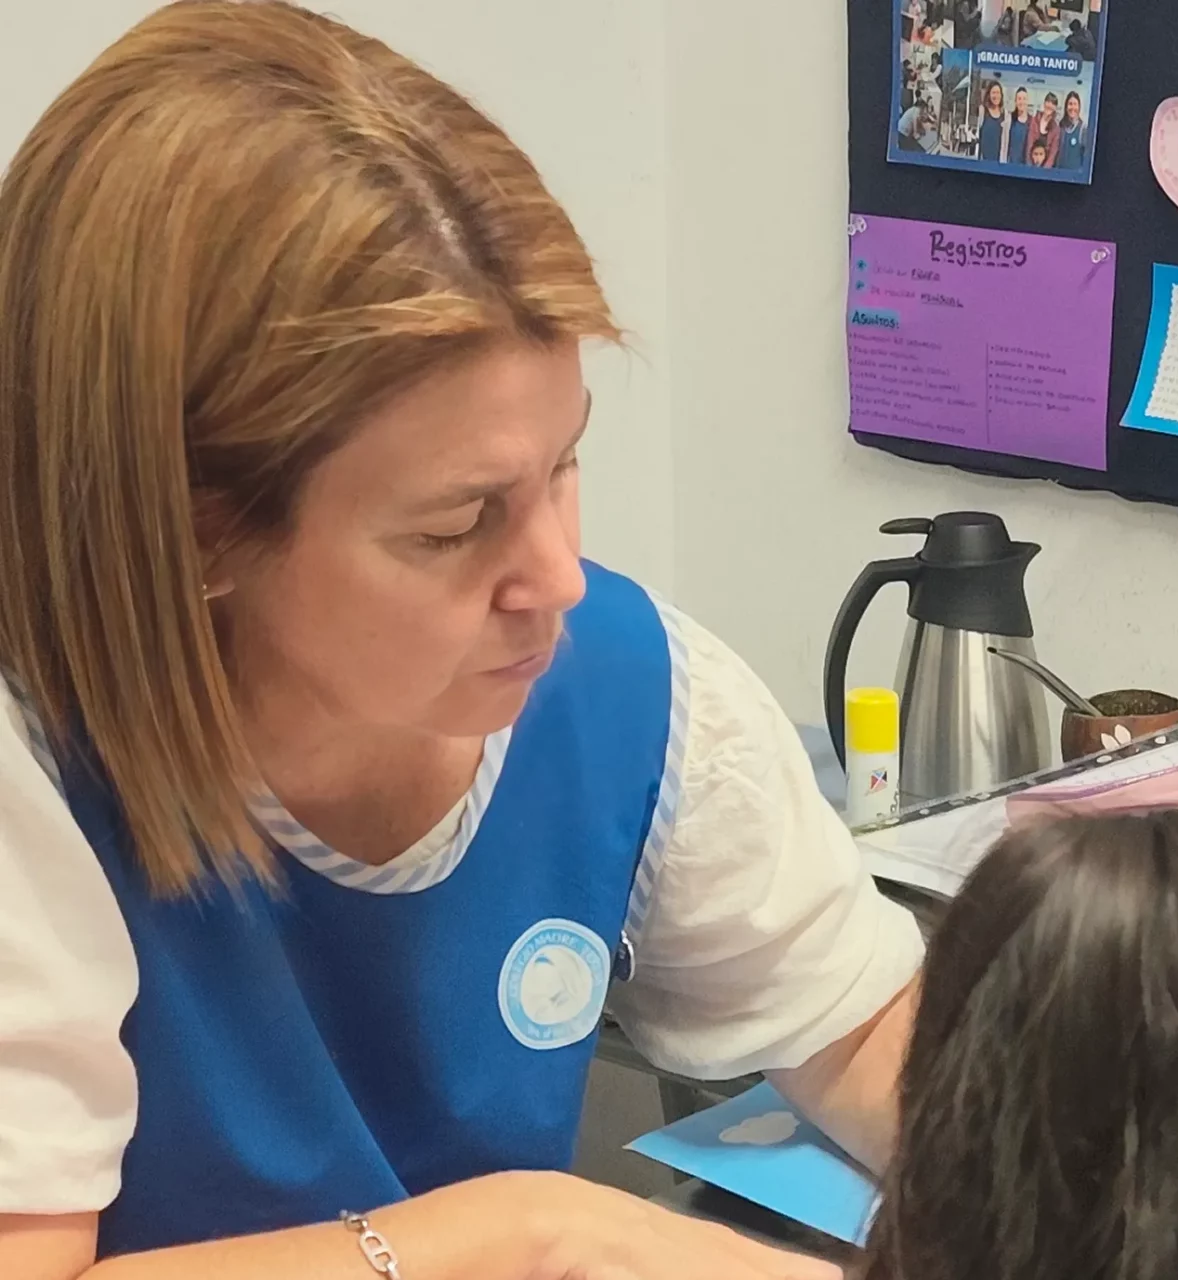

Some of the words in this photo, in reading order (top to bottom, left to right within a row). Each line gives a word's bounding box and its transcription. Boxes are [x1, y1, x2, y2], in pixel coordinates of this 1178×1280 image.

[977, 51, 1020, 65] ¡GRACIAS
[1021, 56, 1041, 67] POR
[1043, 58, 1078, 71] TANTO!
